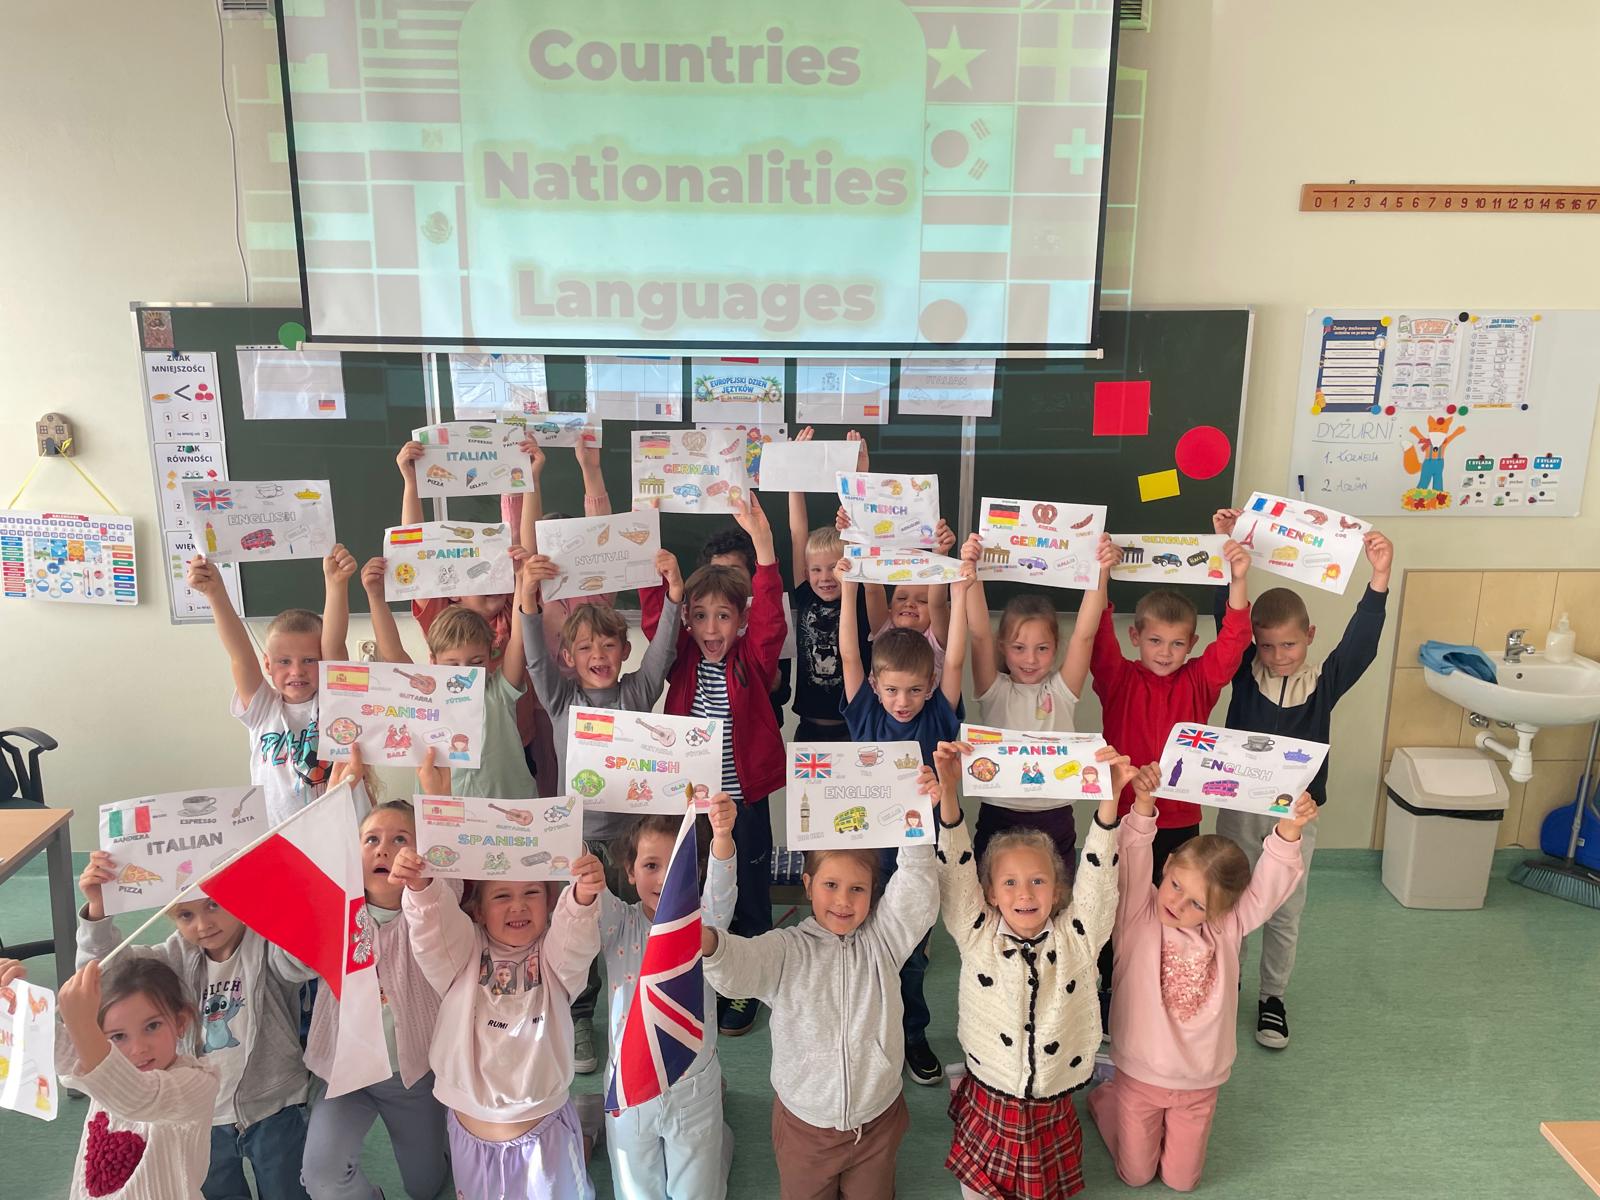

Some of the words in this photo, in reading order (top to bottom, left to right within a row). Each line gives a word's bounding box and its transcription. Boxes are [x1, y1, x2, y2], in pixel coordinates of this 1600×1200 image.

[528, 26, 861, 86] Countries
[483, 146, 908, 206] Nationalities
[1314, 196, 1323, 209] 0
[1332, 196, 1339, 209] 1
[1346, 196, 1355, 209] 2
[1363, 196, 1371, 209] 3
[1379, 196, 1388, 209] 4
[1395, 196, 1404, 209] 5
[1411, 196, 1421, 209] 6
[1428, 196, 1437, 209] 7
[1444, 197, 1452, 209] 8
[1460, 197, 1469, 209] 9
[1475, 197, 1487, 209] 10
[1492, 197, 1503, 209] 11
[1507, 197, 1519, 210] 12
[1523, 197, 1535, 210] 13
[1539, 198, 1551, 210] 14
[1554, 198, 1567, 211] 15
[1570, 198, 1582, 211] 16
[1586, 198, 1599, 211] 17
[517, 269, 876, 332] Languages
[151, 364, 206, 373] MNIEJSZOŚCI
[709, 376, 747, 388] EUROPEJSKI
[721, 385, 754, 394] JĘZYKÓW
[167, 453, 213, 463] RÓWNOŚCI
[446, 450, 498, 462] ITALIAN
[663, 463, 720, 476] GERMAN
[427, 478, 445, 488] PIZZA
[469, 481, 489, 490] GELATO
[863, 503, 908, 515] FRENCH
[227, 511, 297, 526] ENGLISH
[1141, 535, 1199, 546] GERMAN
[1269, 522, 1324, 548] FRENCH
[1010, 535, 1070, 550] GERMAN
[416, 547, 480, 560] SPANISH
[574, 550, 630, 567] ITALIAN
[876, 558, 929, 566] FRENCH
[361, 704, 440, 721] SPANISH
[998, 745, 1068, 756] SPANISH
[604, 755, 680, 774] SPANISH
[1201, 757, 1274, 782] ENGLISH
[824, 785, 892, 800] ENGLISH
[232, 815, 255, 827] PASTA
[146, 831, 223, 855] ITALIAN
[457, 833, 539, 847] SPANISH
[118, 885, 143, 895] PIZZA
[487, 1019, 508, 1029] RUMI
